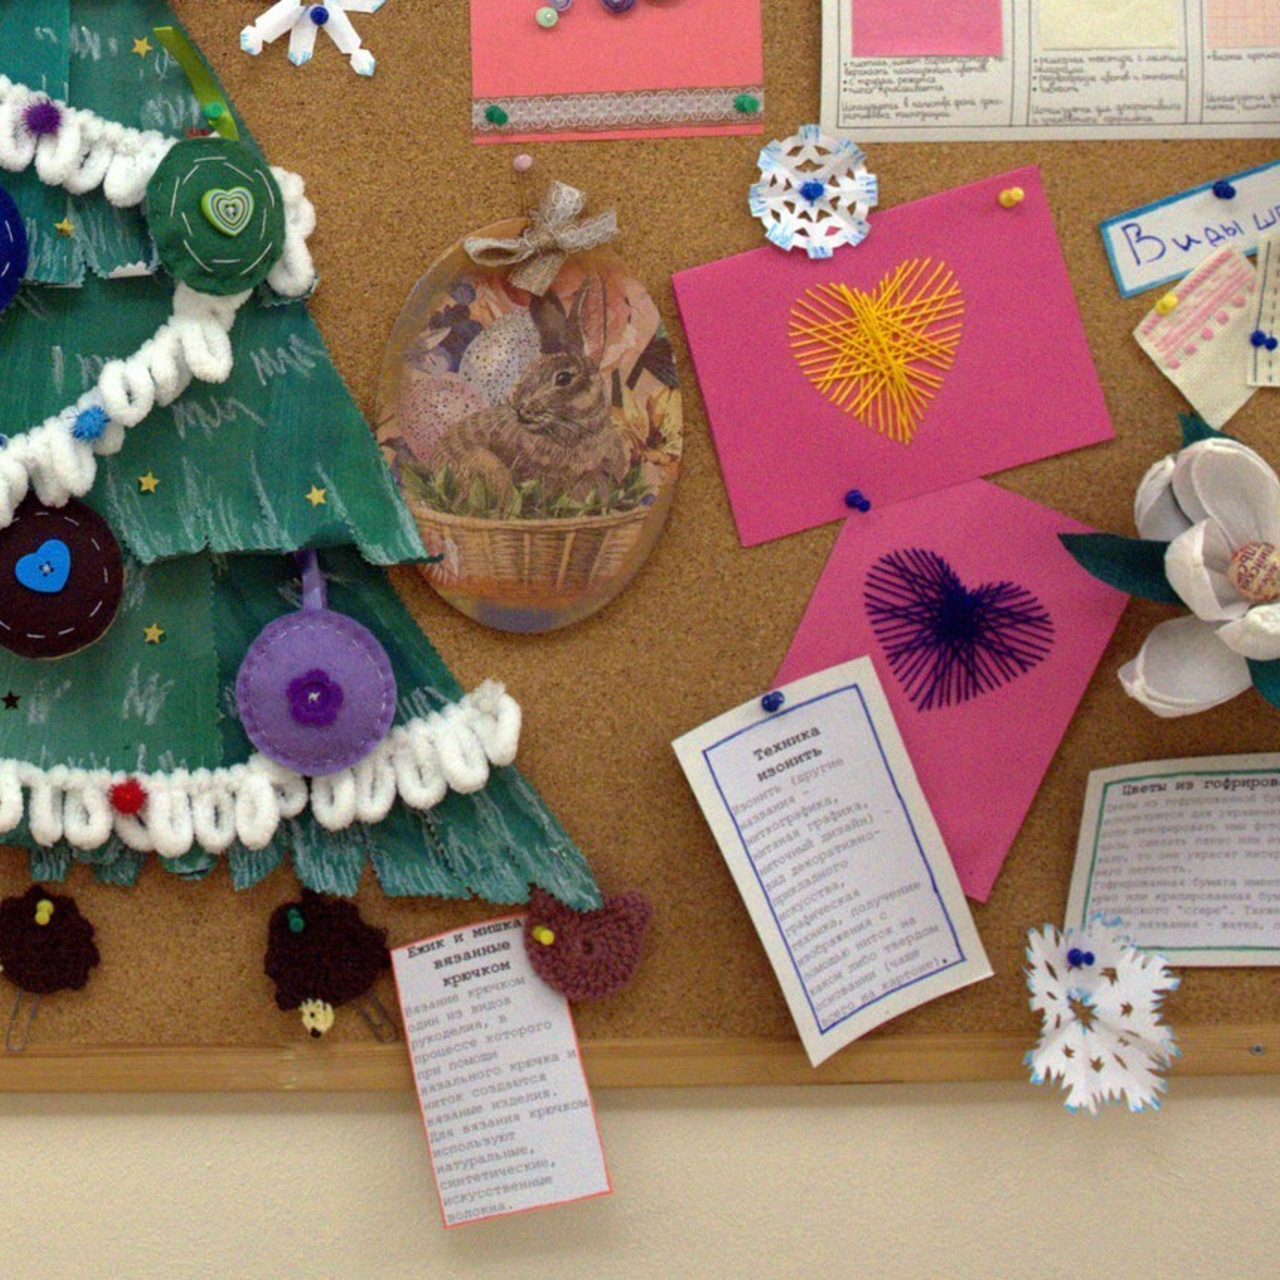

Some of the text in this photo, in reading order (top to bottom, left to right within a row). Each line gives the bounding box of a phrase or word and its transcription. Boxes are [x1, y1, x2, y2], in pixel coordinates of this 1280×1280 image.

[1121, 221, 1244, 266] Виды
[753, 727, 821, 761] Техника
[757, 749, 823, 782] изонить
[1122, 783, 1167, 795] Цветы
[1175, 780, 1194, 790] из
[453, 933, 464, 943] и
[472, 919, 522, 938] мишка
[433, 941, 511, 969] вязанные
[442, 961, 511, 987] крючком
